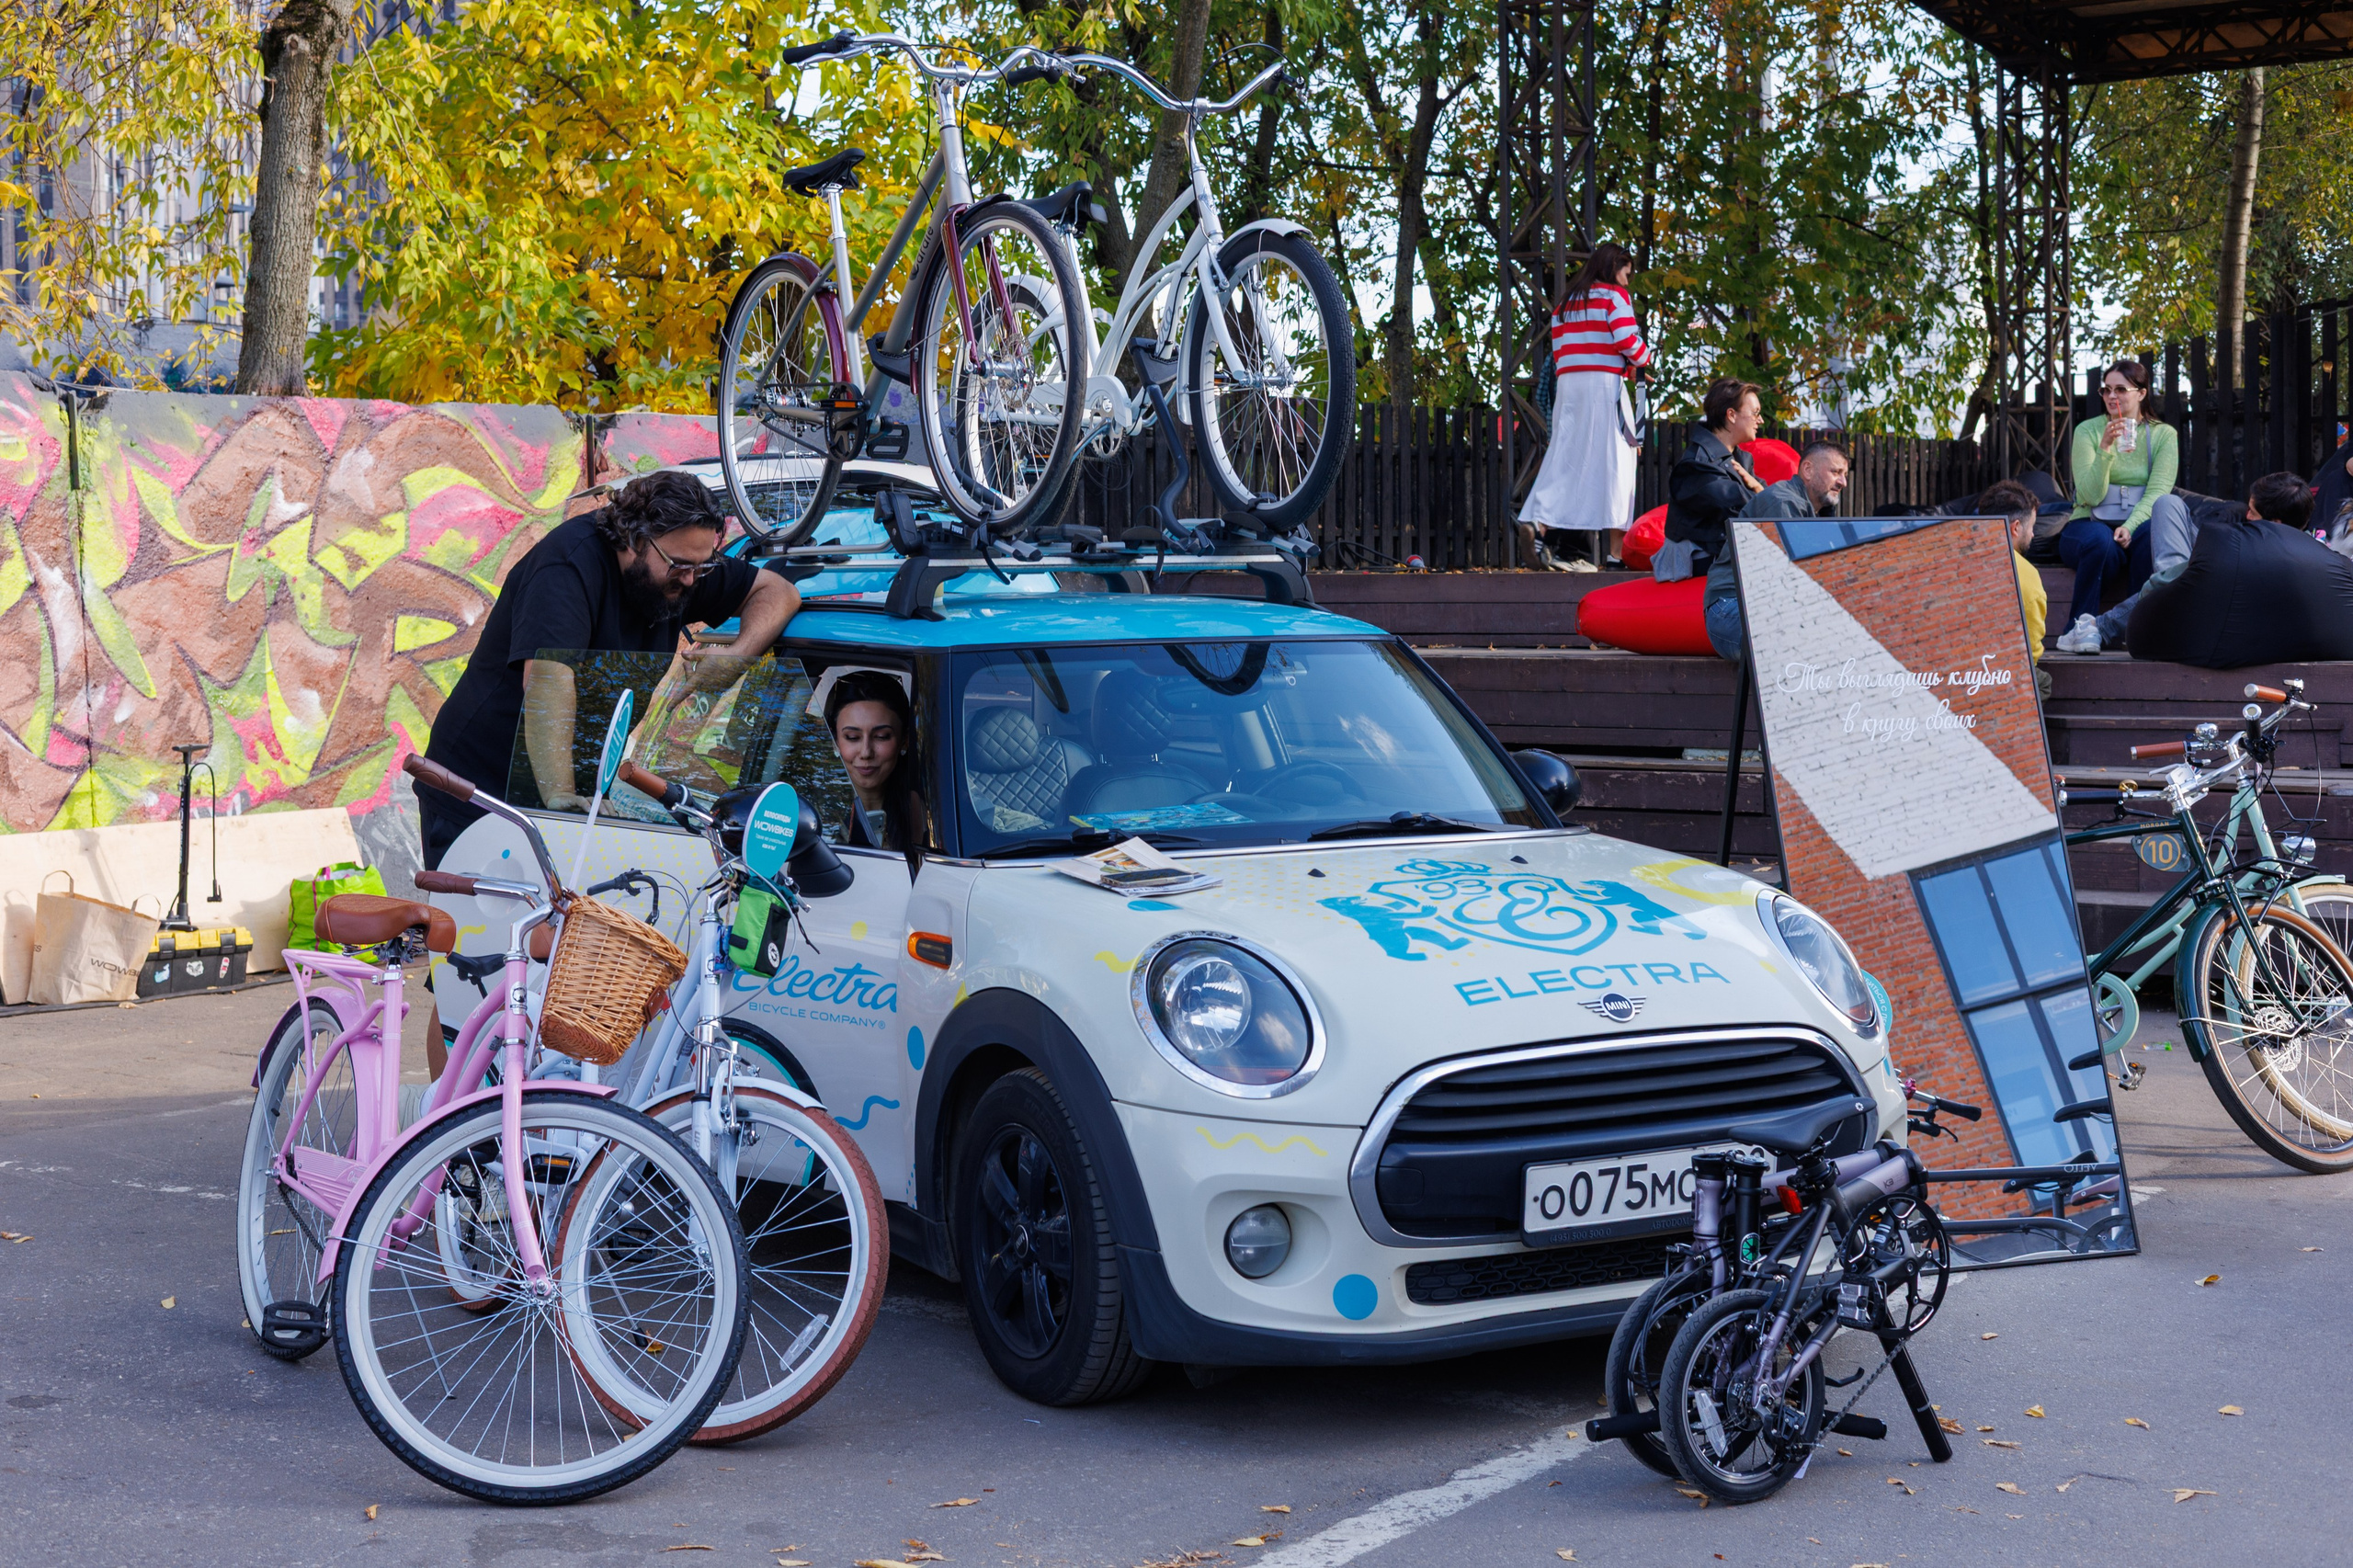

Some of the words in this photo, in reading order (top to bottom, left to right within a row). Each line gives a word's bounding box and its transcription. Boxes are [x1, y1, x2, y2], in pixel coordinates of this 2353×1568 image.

[1777, 662, 1832, 693] Ты
[1948, 654, 2011, 696] клубно
[1842, 701, 1860, 733] в
[1861, 716, 1919, 743] кругу
[1926, 699, 1977, 730] своих
[754, 820, 794, 837] WOWBIKES
[2148, 840, 2173, 864] 10
[90, 958, 140, 978] WOWBI
[1453, 962, 1732, 1006] ELECTRA
[1864, 977, 1886, 1005] БИТЬСЯ
[749, 1002, 805, 1017] BICYCLE
[1605, 1000, 1631, 1012] MINI
[1572, 1231, 1587, 1241] 500
[1588, 1229, 1604, 1239] 500
